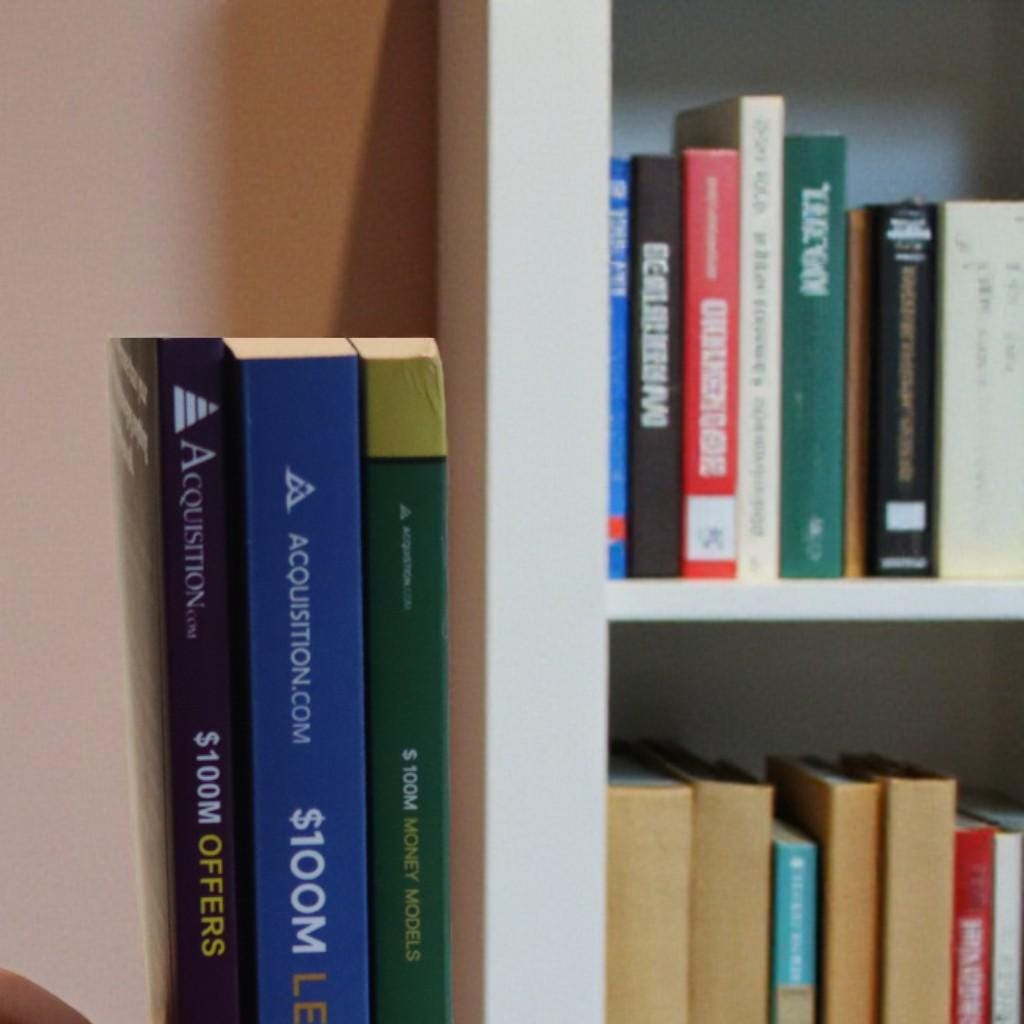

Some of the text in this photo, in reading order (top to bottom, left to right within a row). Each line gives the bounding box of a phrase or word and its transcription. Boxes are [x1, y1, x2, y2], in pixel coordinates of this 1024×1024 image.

[286, 532, 312, 745] ACQUISITION.COM
[192, 730, 225, 958] $100M OFFERS
[289, 808, 327, 955] $100M
[403, 817, 421, 882] MONEY
[404, 888, 422, 962] MODELS
